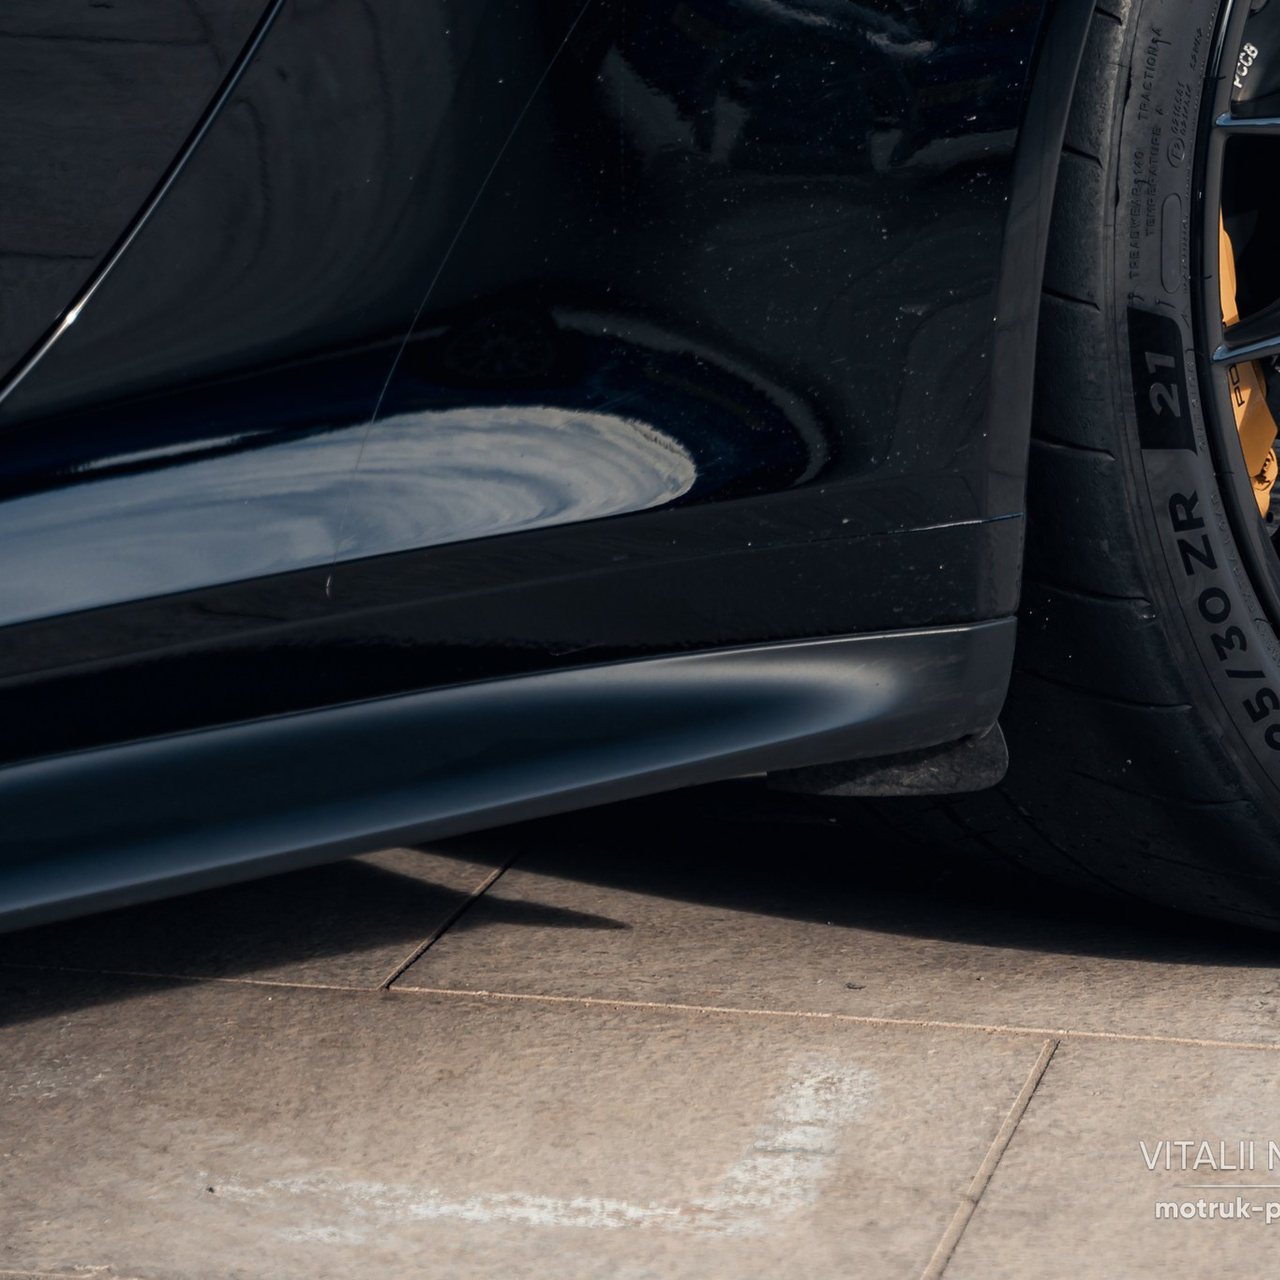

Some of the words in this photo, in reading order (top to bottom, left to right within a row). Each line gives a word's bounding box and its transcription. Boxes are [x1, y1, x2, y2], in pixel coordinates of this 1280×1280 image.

[1136, 41, 1160, 121] TRACTION
[1233, 42, 1259, 89] PCCB
[1144, 125, 1162, 236] TEMPERATURE
[1145, 351, 1182, 419] 21
[1167, 489, 1218, 577] ZR
